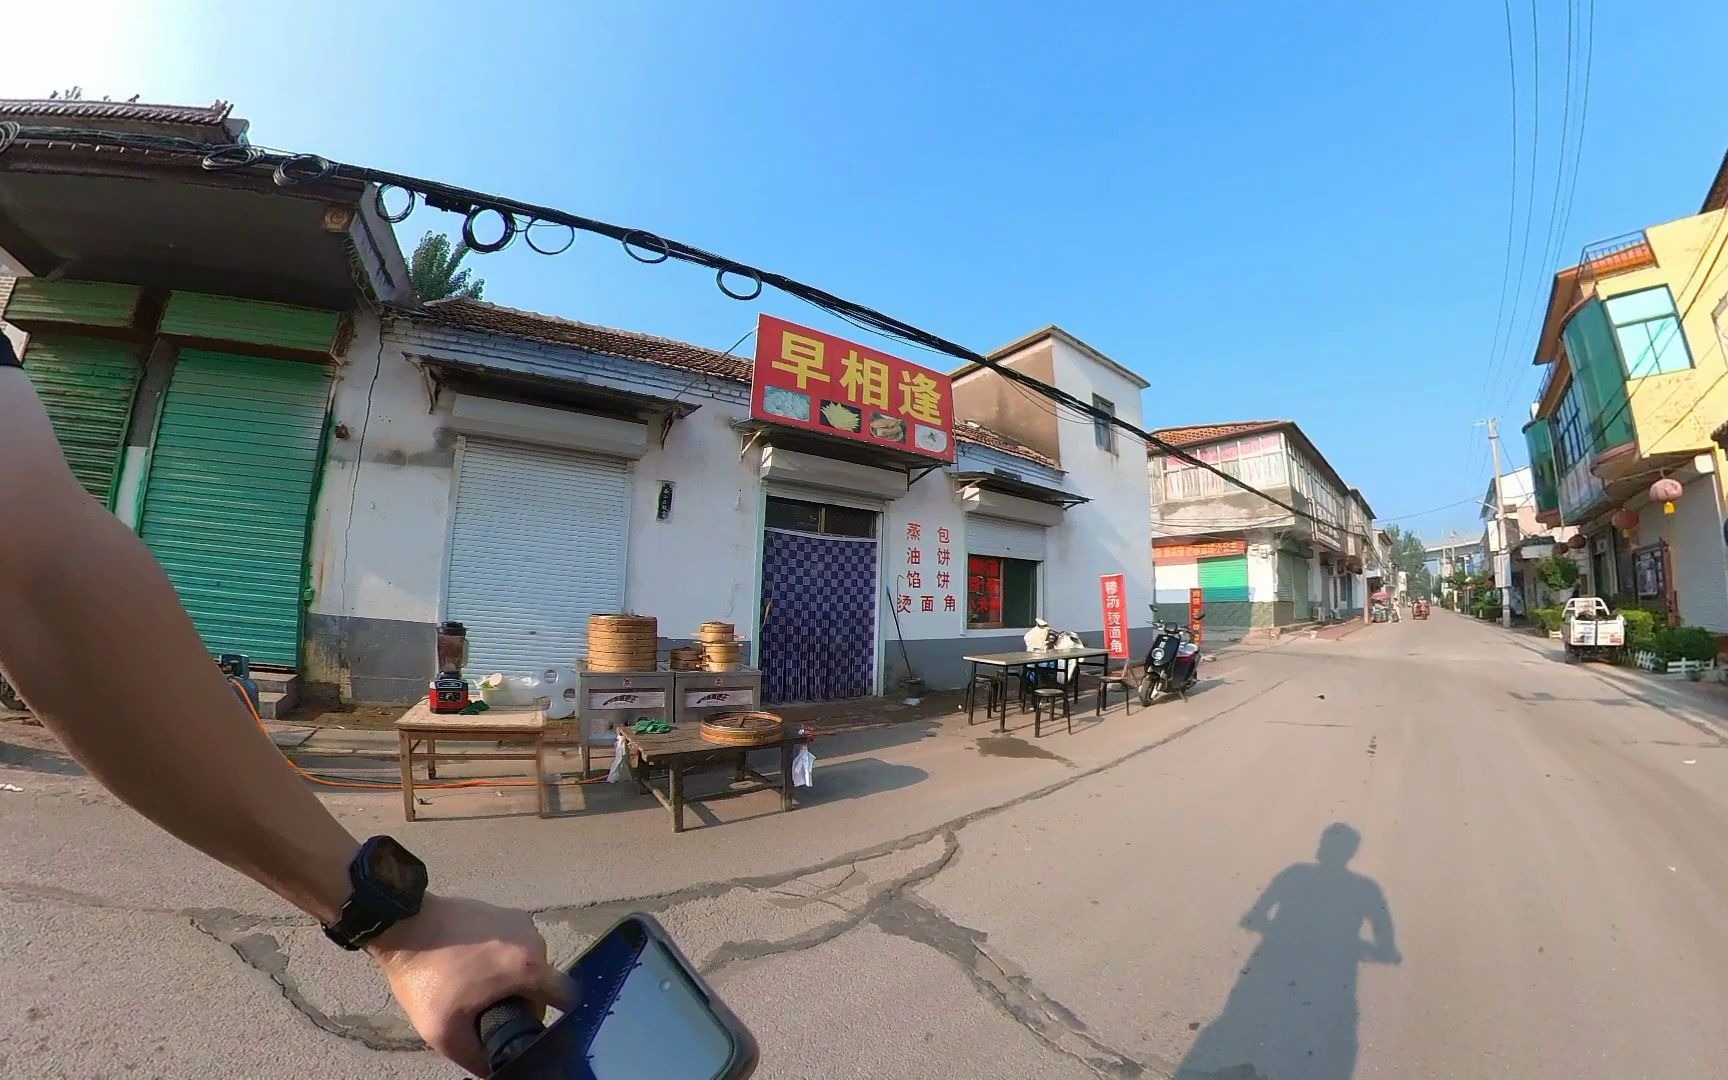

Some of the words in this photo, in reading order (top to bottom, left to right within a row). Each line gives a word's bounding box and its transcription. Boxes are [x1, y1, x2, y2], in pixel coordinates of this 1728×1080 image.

[771, 330, 943, 426] 早相逢
[906, 522, 950, 544] 蒸包
[906, 547, 951, 567] 油饼
[906, 570, 950, 590] 馅饼
[897, 594, 956, 614] 烫面角
